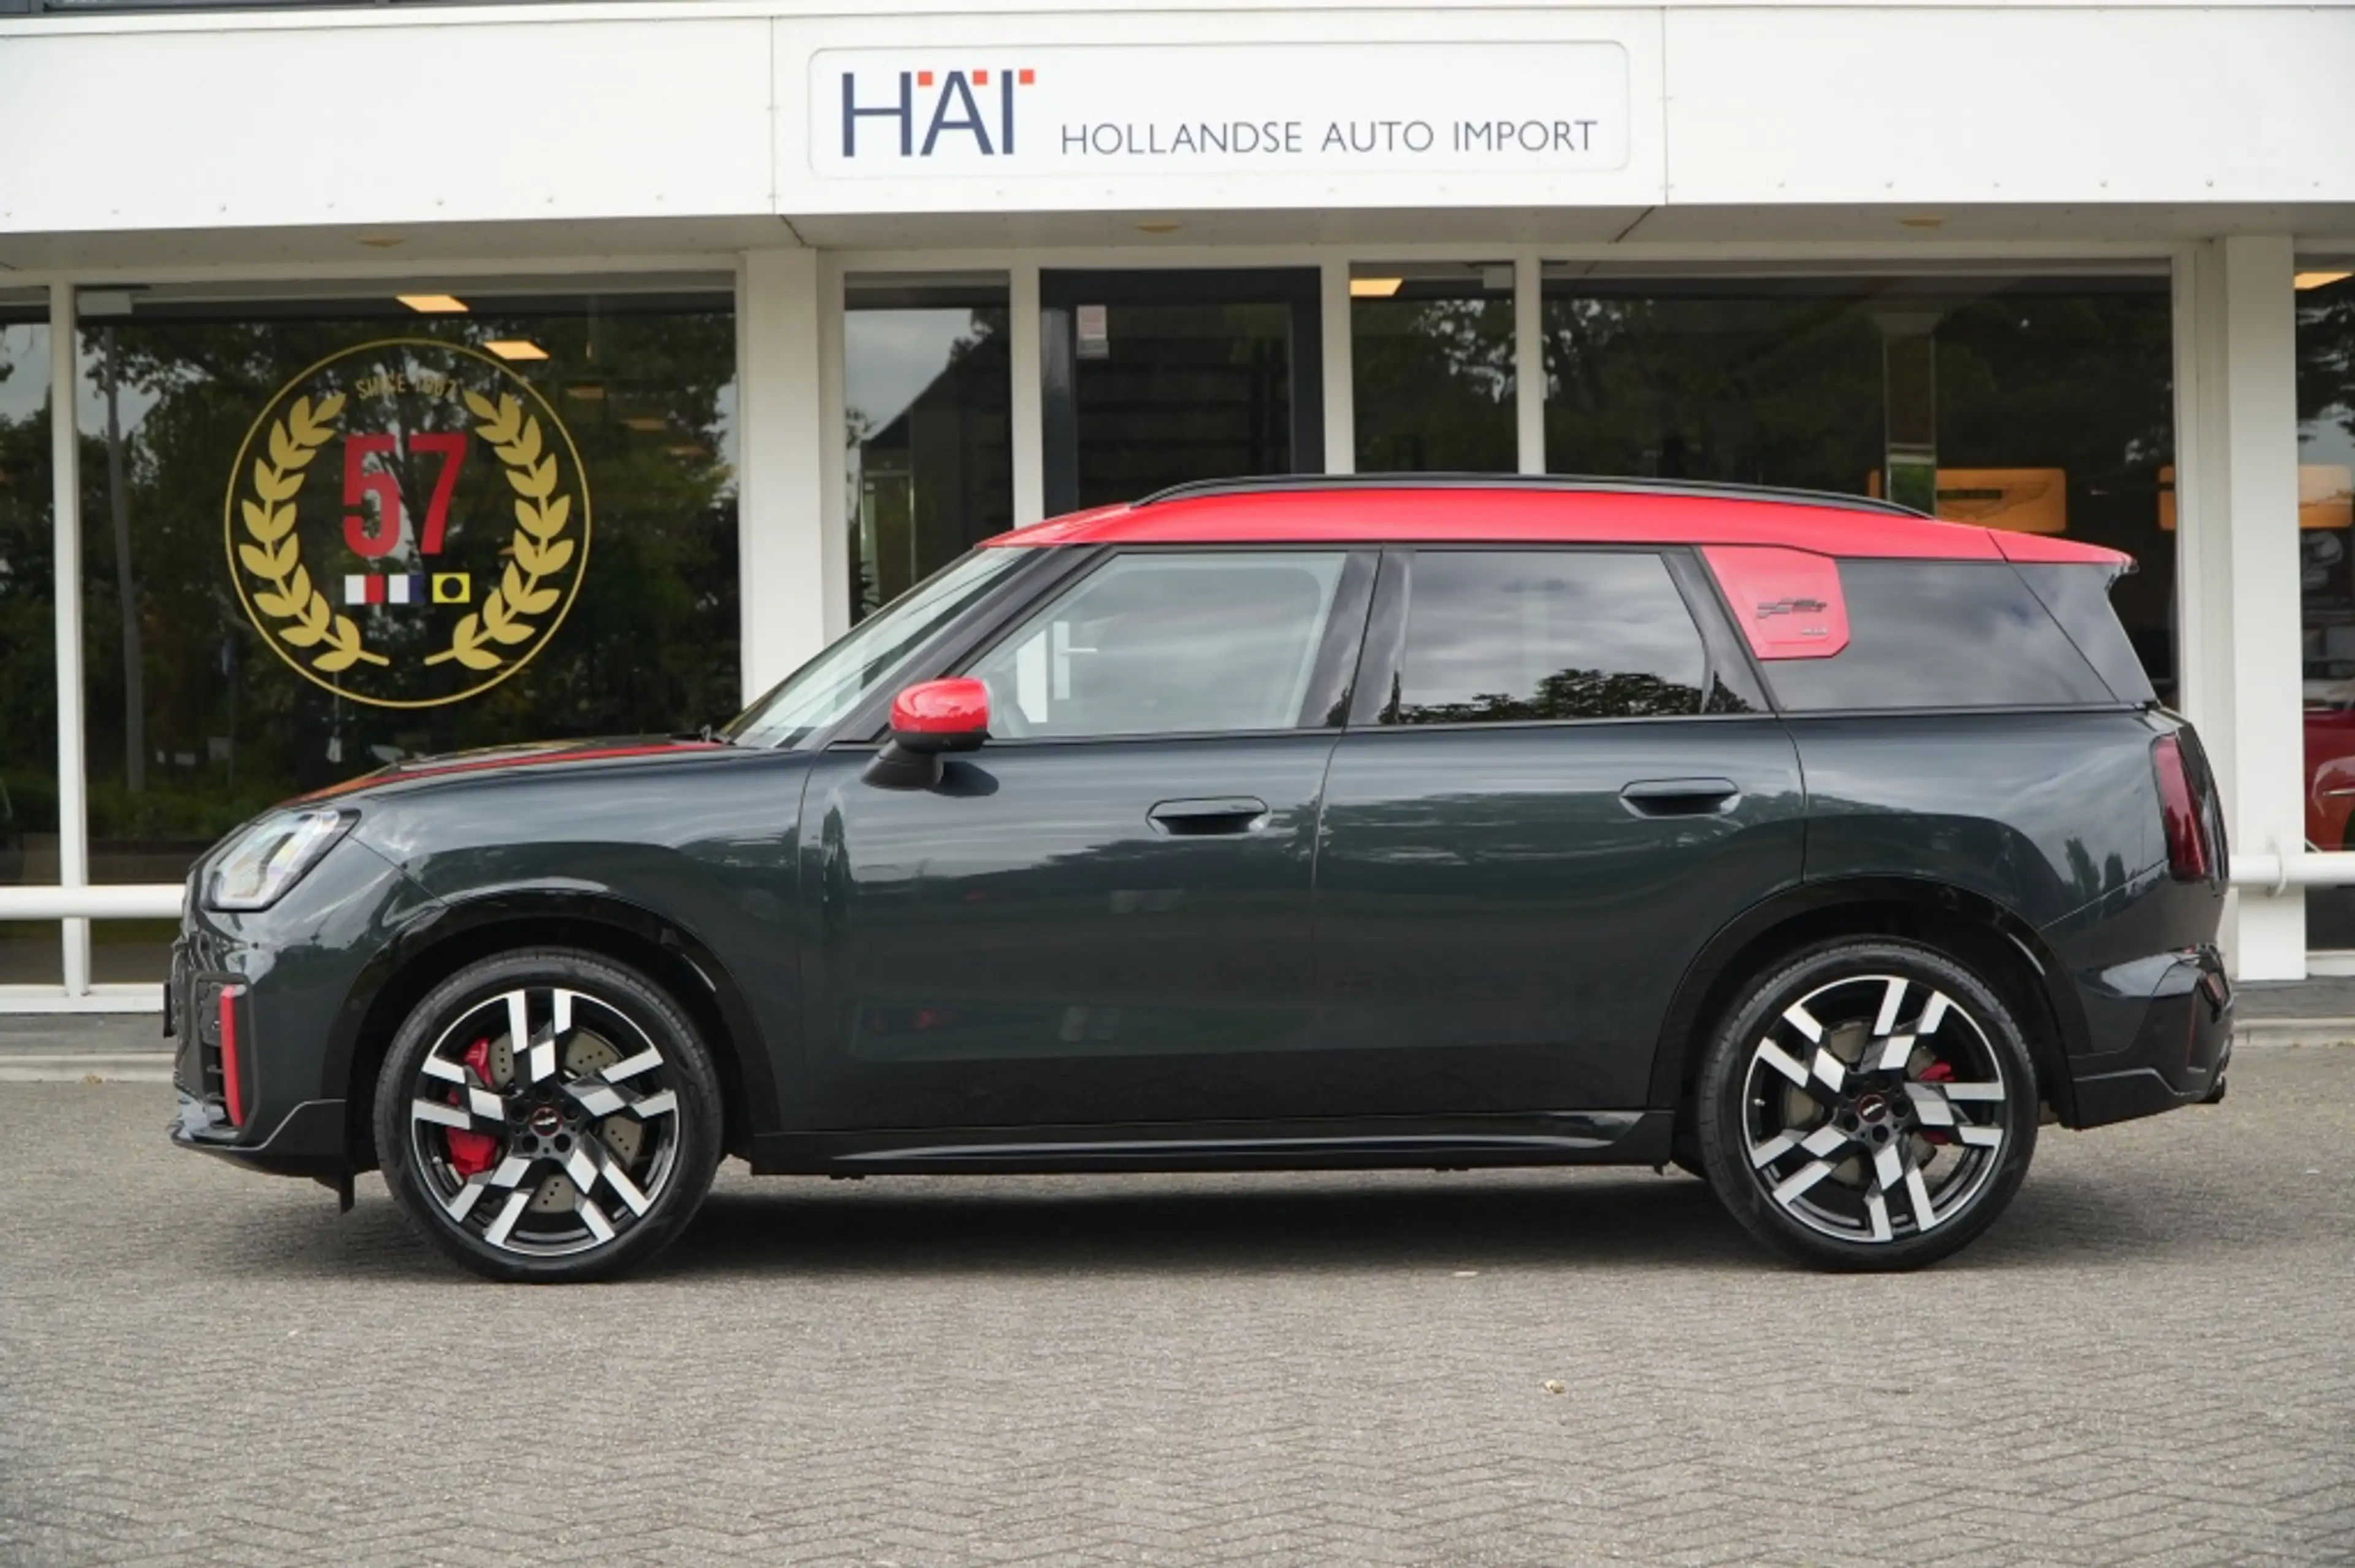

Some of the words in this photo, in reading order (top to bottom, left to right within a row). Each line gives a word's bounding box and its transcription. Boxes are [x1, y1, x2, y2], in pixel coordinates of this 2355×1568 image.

[1062, 122, 1301, 155] HOLLANDSE
[1322, 121, 1434, 152] AUTO
[1453, 121, 1597, 151] IMPORT
[354, 373, 406, 400] SINCE
[343, 432, 467, 557] 57
